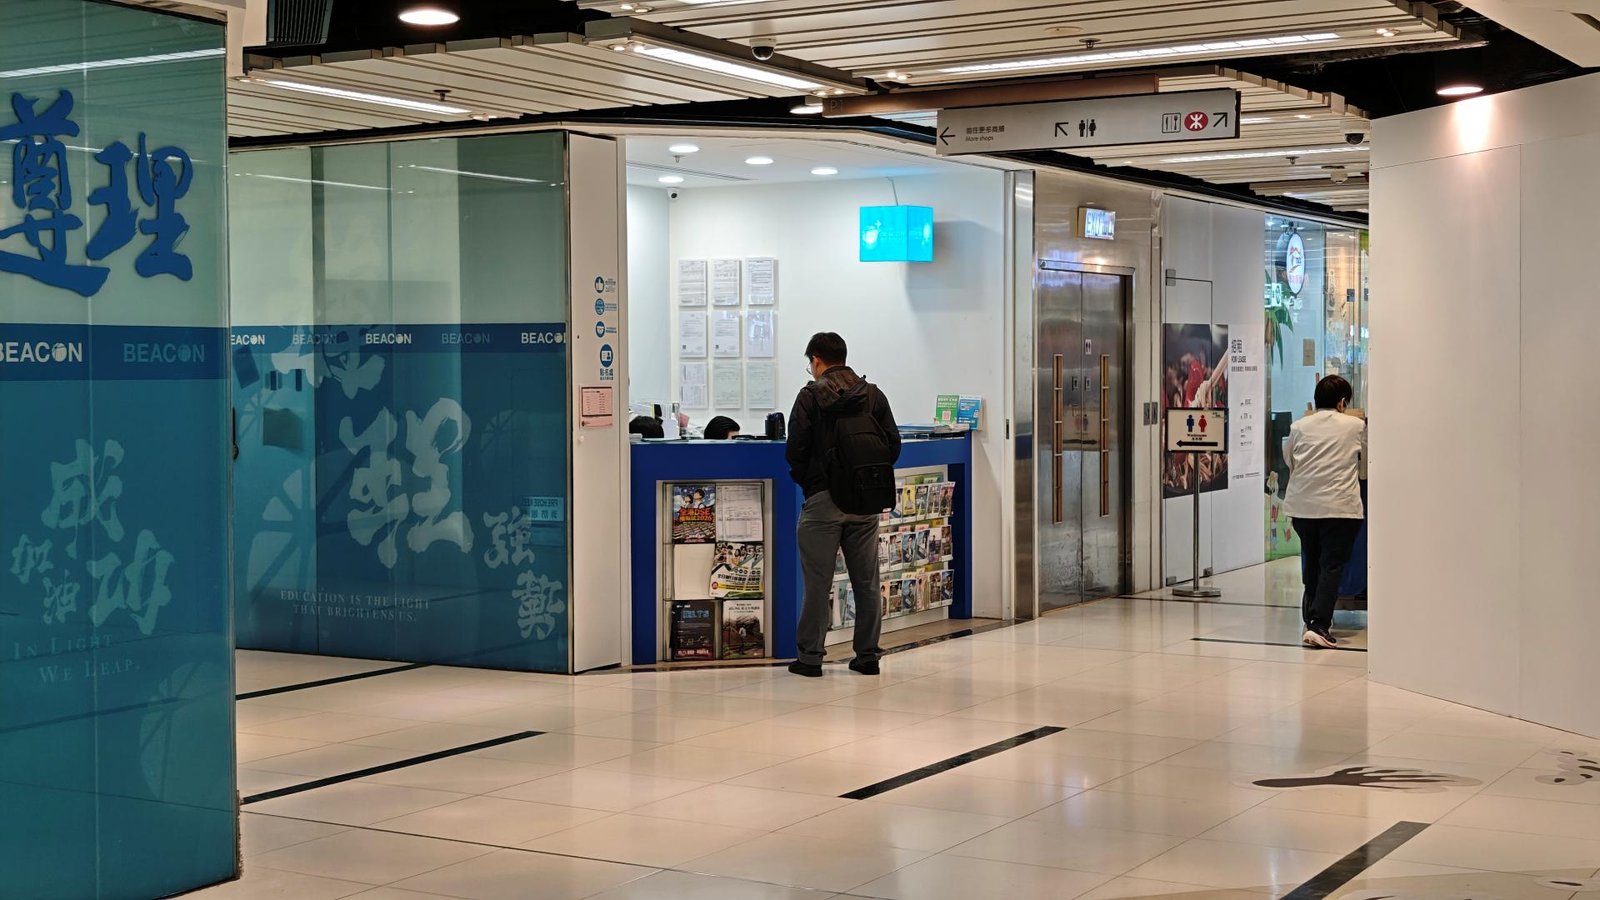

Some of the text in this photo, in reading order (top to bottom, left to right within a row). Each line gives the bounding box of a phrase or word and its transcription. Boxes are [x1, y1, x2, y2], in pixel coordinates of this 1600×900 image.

[365, 333, 412, 344] BEACON
[441, 333, 490, 344] BEACON
[521, 332, 566, 344] BEACO
[123, 344, 205, 363] BEACON
[280, 590, 346, 604] EDUCATION
